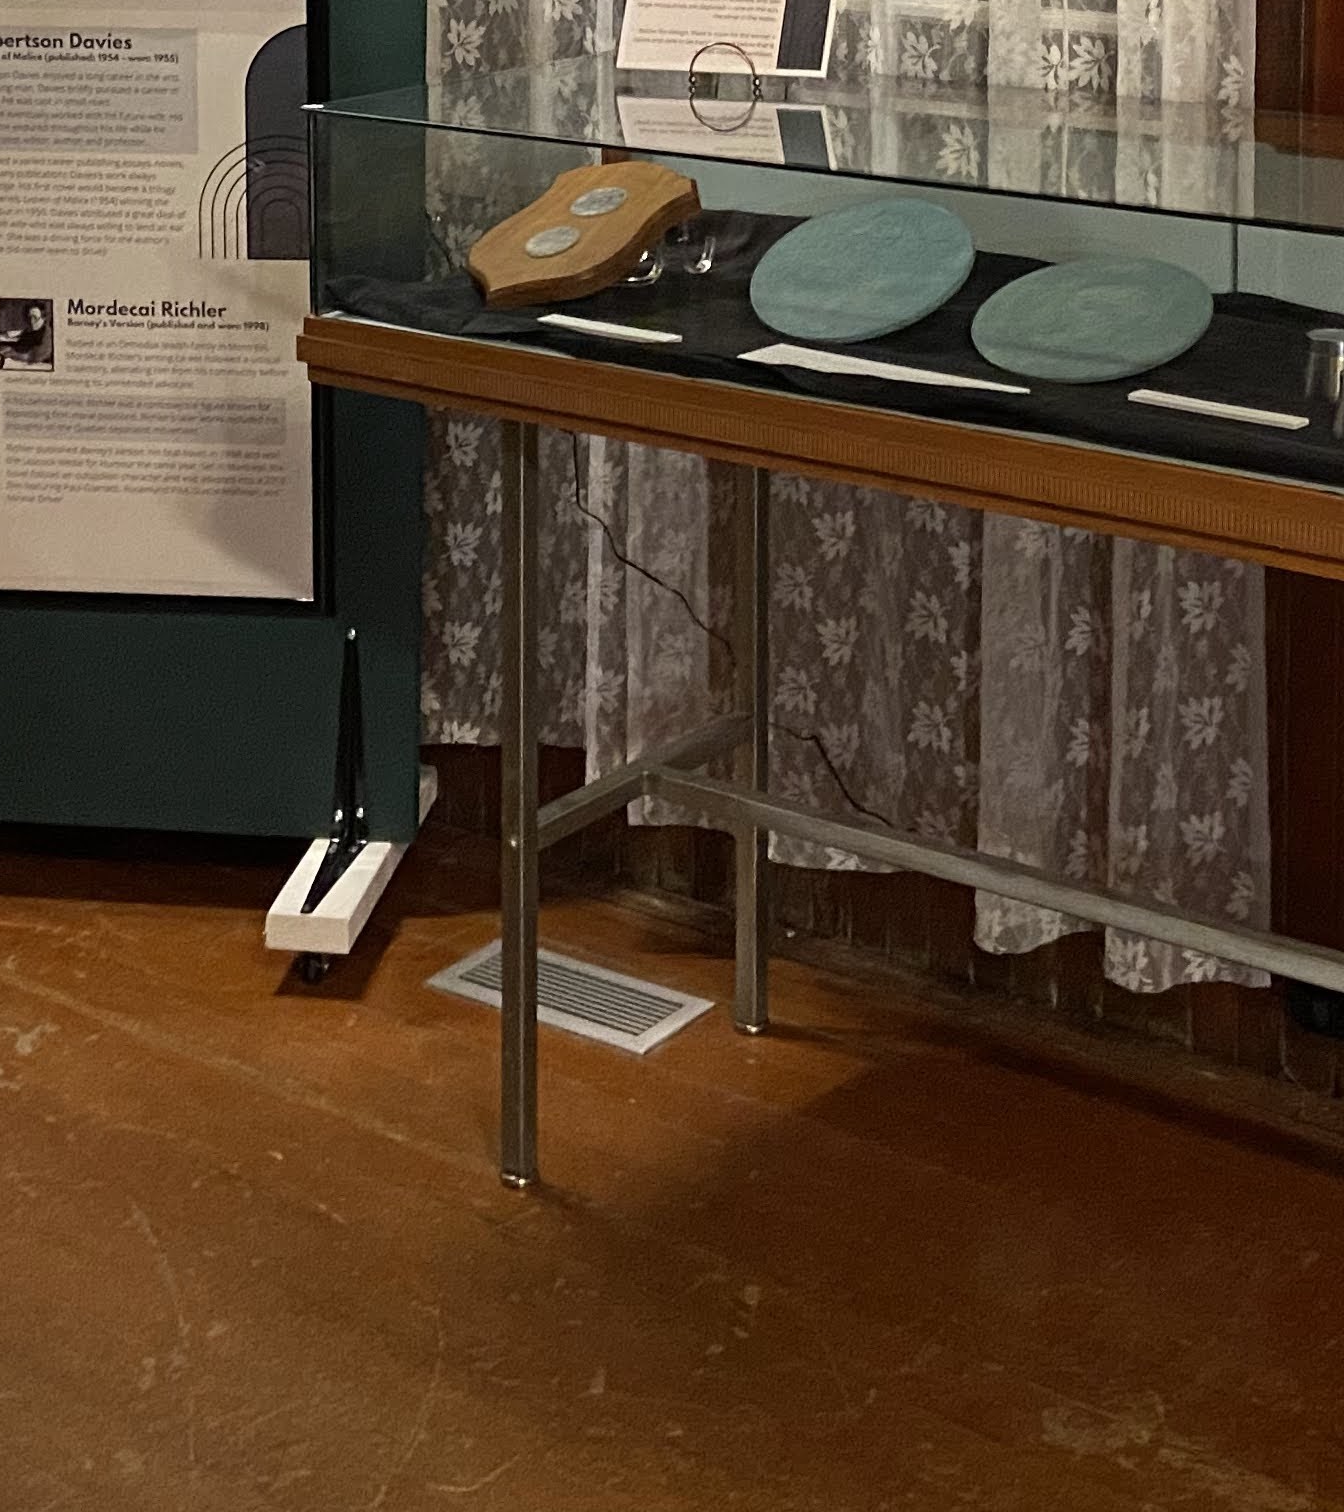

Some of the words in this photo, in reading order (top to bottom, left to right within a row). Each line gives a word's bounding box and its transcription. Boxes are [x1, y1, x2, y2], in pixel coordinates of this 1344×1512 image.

[69, 32, 132, 49] Davies
[67, 299, 155, 317] Mordecai
[161, 301, 227, 318] Richler
